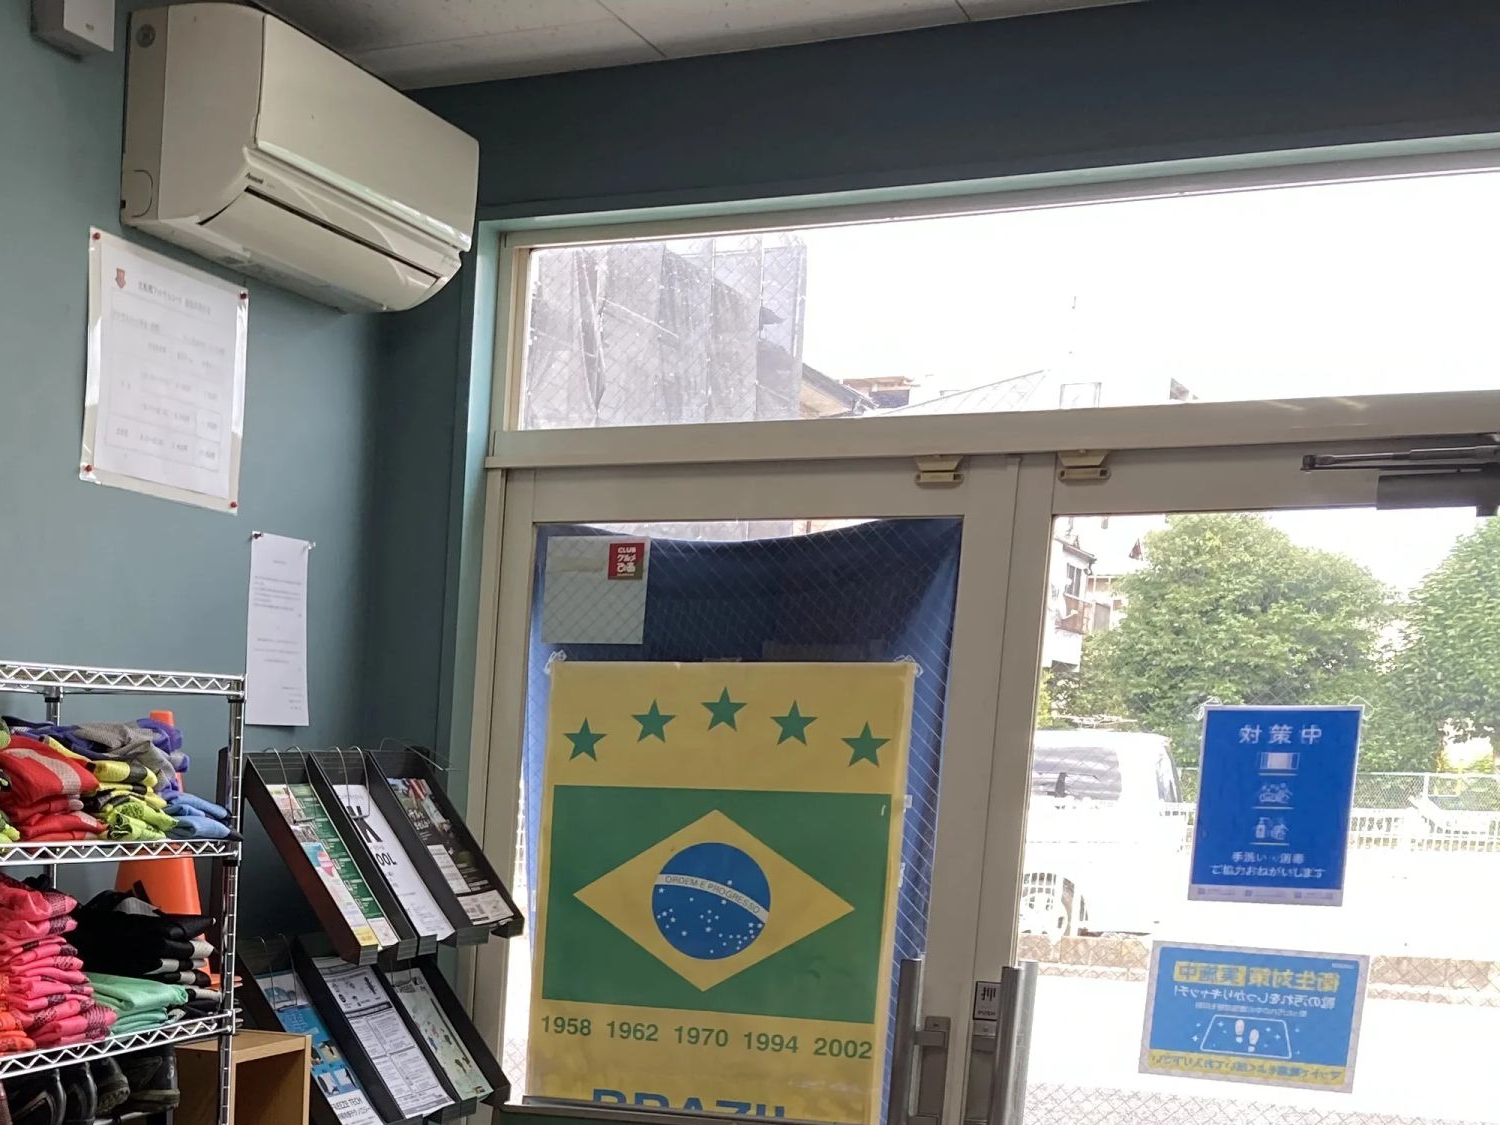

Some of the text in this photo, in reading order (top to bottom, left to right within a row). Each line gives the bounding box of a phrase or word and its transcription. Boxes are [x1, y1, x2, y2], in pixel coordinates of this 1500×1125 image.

[617, 546, 636, 554] CLUB
[1238, 724, 1323, 745] 対策中
[707, 883, 761, 915] PROGRESSO
[541, 1016, 873, 1060] 1958 1962 1970 1994 2002
